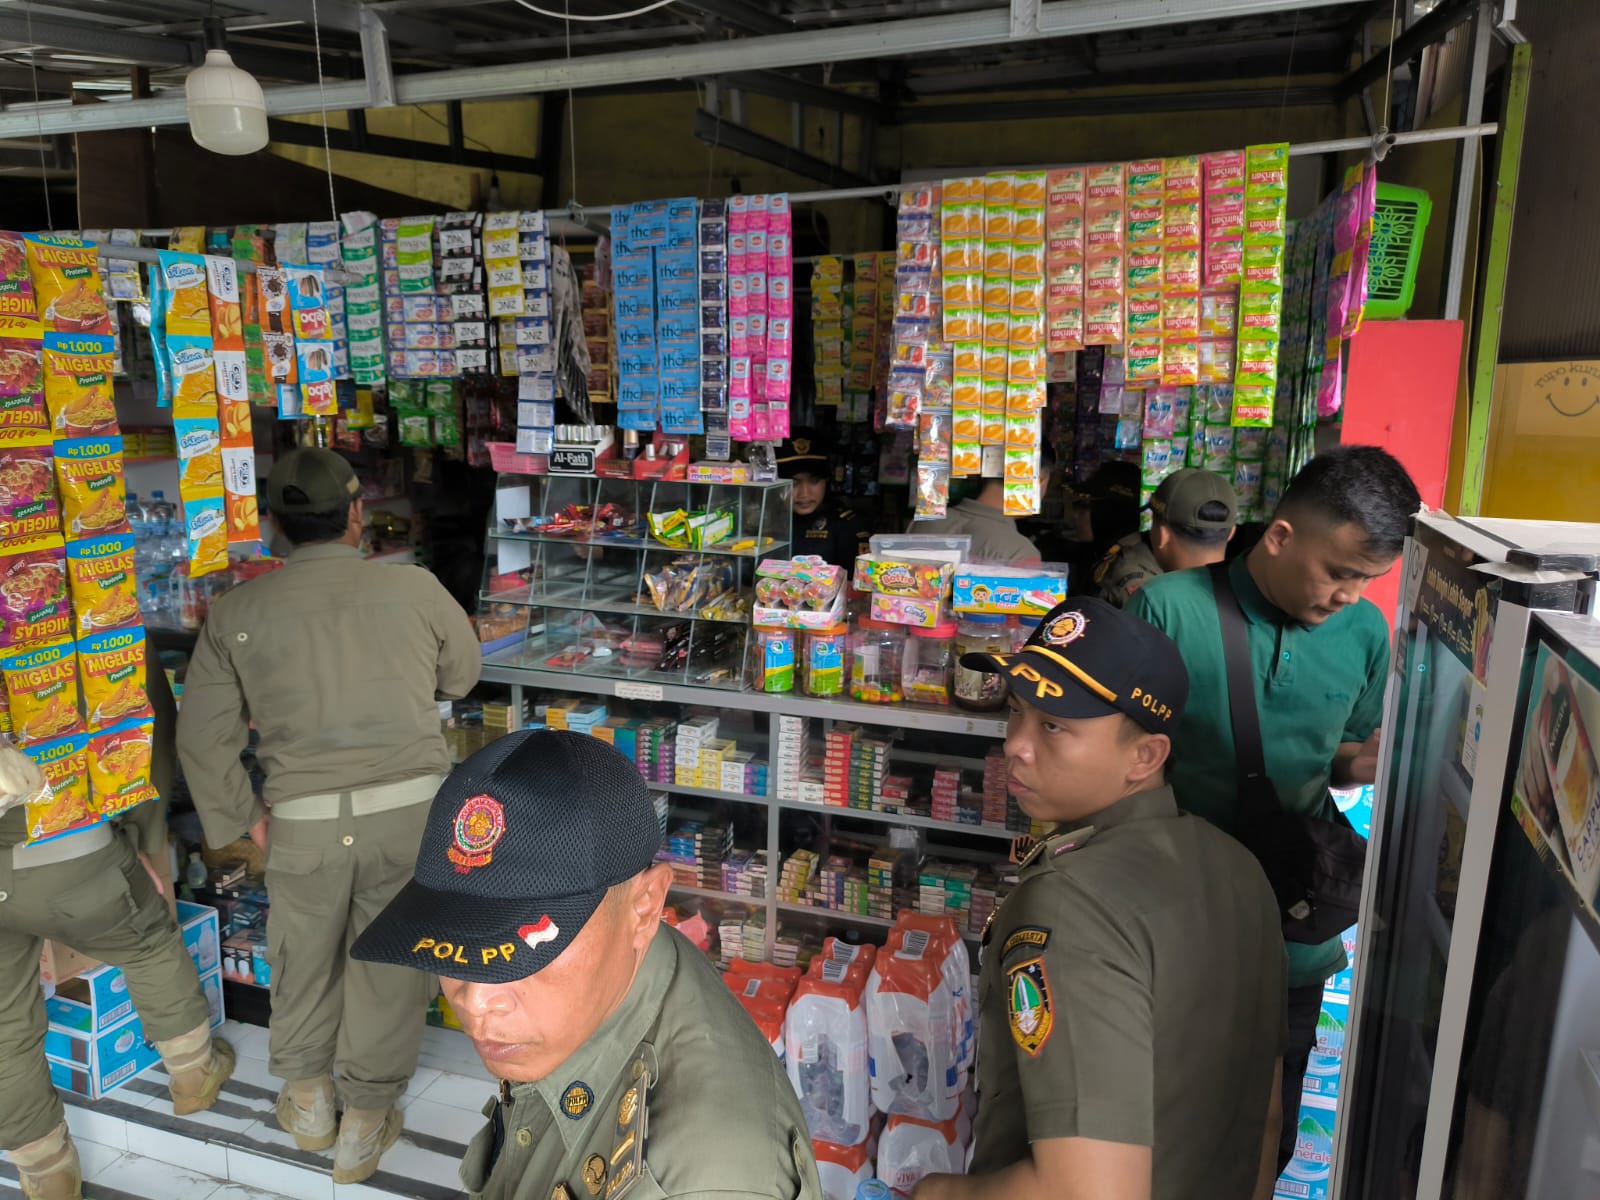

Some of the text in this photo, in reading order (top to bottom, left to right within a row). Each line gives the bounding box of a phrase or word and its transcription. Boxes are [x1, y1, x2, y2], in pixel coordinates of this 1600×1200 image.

[1130, 163, 1160, 173] NutriSari
[1130, 209, 1160, 219] NutriSari
[39, 246, 98, 266] MIGELAS
[1129, 255, 1159, 265] NutriSari
[0, 296, 37, 314] MIGE
[1129, 301, 1159, 312] NutriSari
[69, 341, 103, 353] 1.000
[1129, 347, 1159, 357] NutriSari
[55, 357, 114, 375] MIGELAS
[0, 409, 47, 426] MIGELA
[79, 443, 111, 457] 1.000
[554, 453, 589, 464] Al-Fath
[66, 459, 122, 478] MIGELAS
[1, 514, 60, 537] MIGELAS
[91, 541, 122, 556] 1.000
[79, 556, 135, 579] MIGELAS
[994, 592, 1021, 604] ICE
[15, 616, 70, 641] MIGELAS
[102, 633, 134, 650] 1.000
[27, 648, 61, 666] 1.000
[88, 647, 145, 674] MIGELAS
[13, 661, 75, 690] MIGELAS
[1009, 662, 1064, 699] PP
[40, 742, 74, 762] 1.000
[45, 755, 87, 781] GELAS
[412, 937, 516, 965] POL PP
[1297, 1140, 1313, 1151] Le
[1294, 1148, 1332, 1163] nerale
